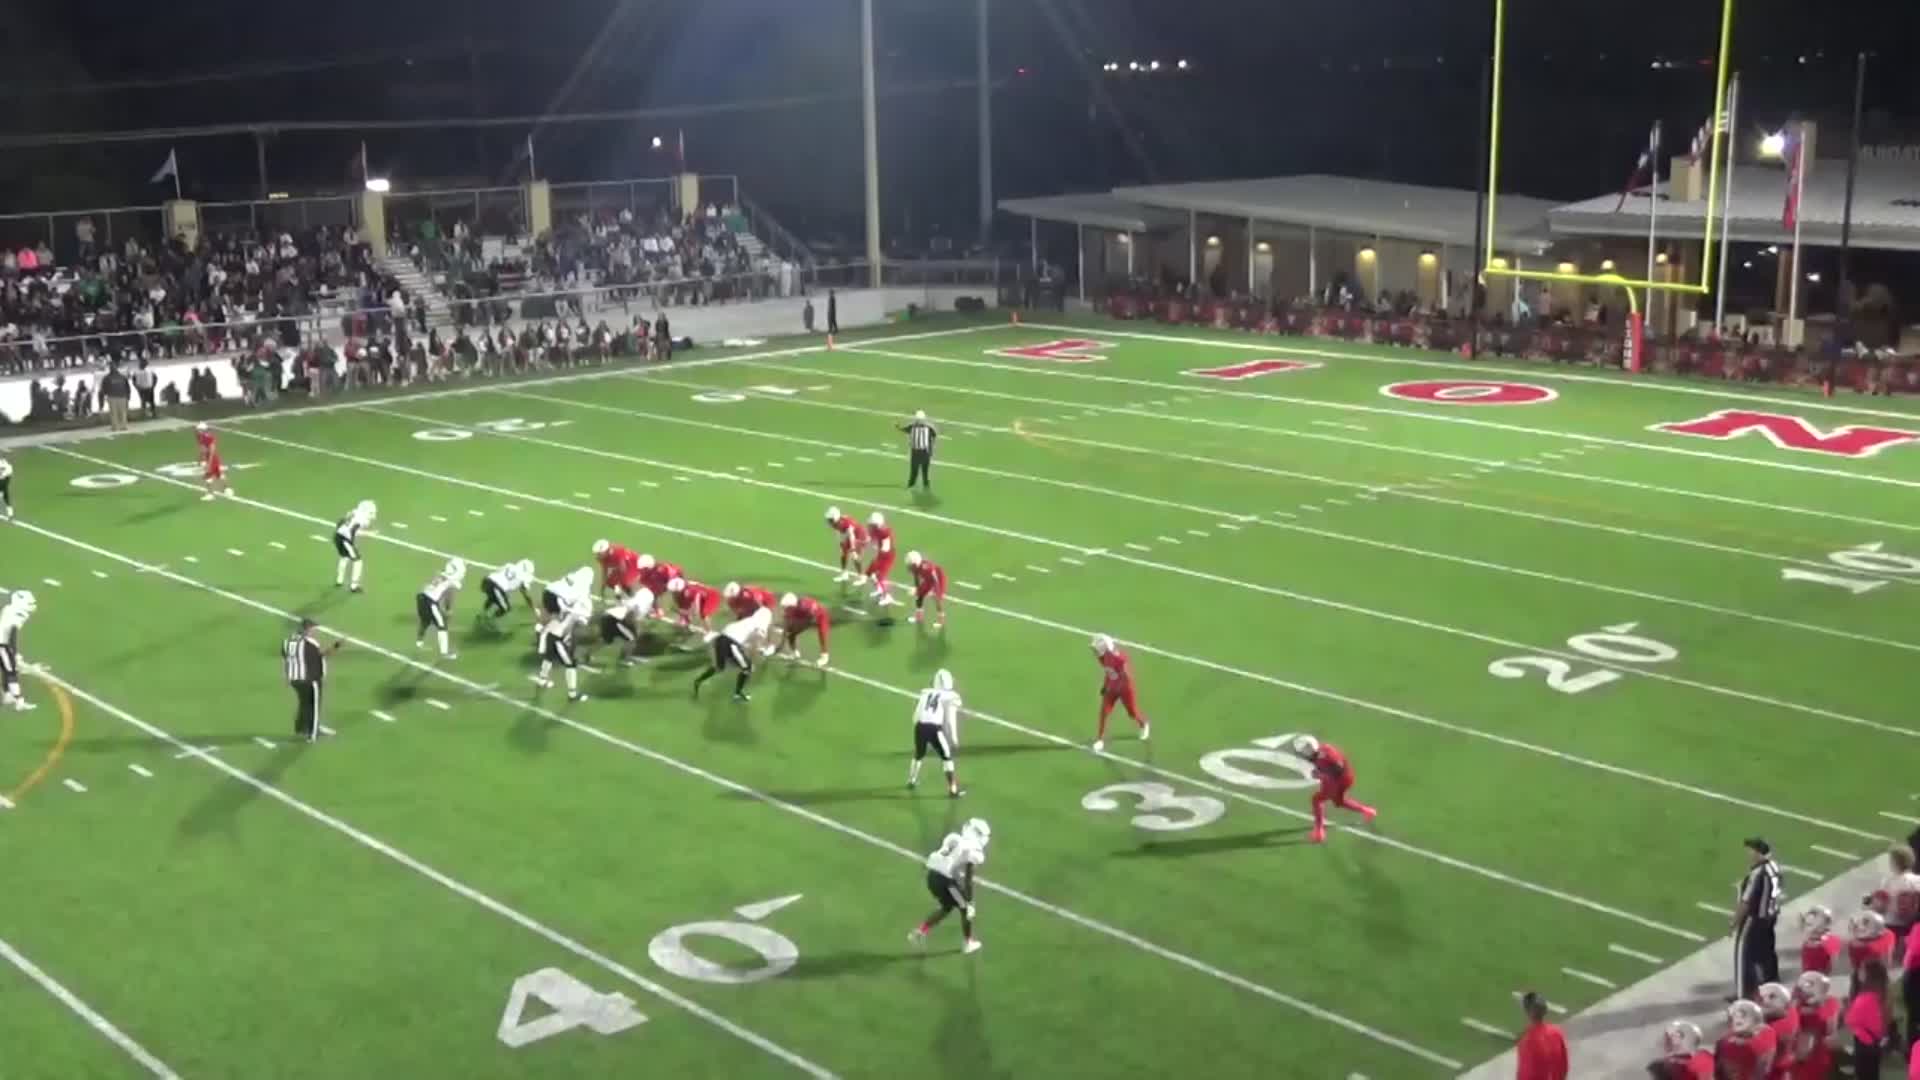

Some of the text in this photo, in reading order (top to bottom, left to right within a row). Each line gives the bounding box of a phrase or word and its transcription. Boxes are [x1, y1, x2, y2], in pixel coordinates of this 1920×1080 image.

[1781, 547, 1920, 595] 10
[1488, 631, 1679, 694] 20
[924, 692, 942, 715] 14
[1081, 747, 1321, 832] 30
[498, 920, 800, 1048] 40
